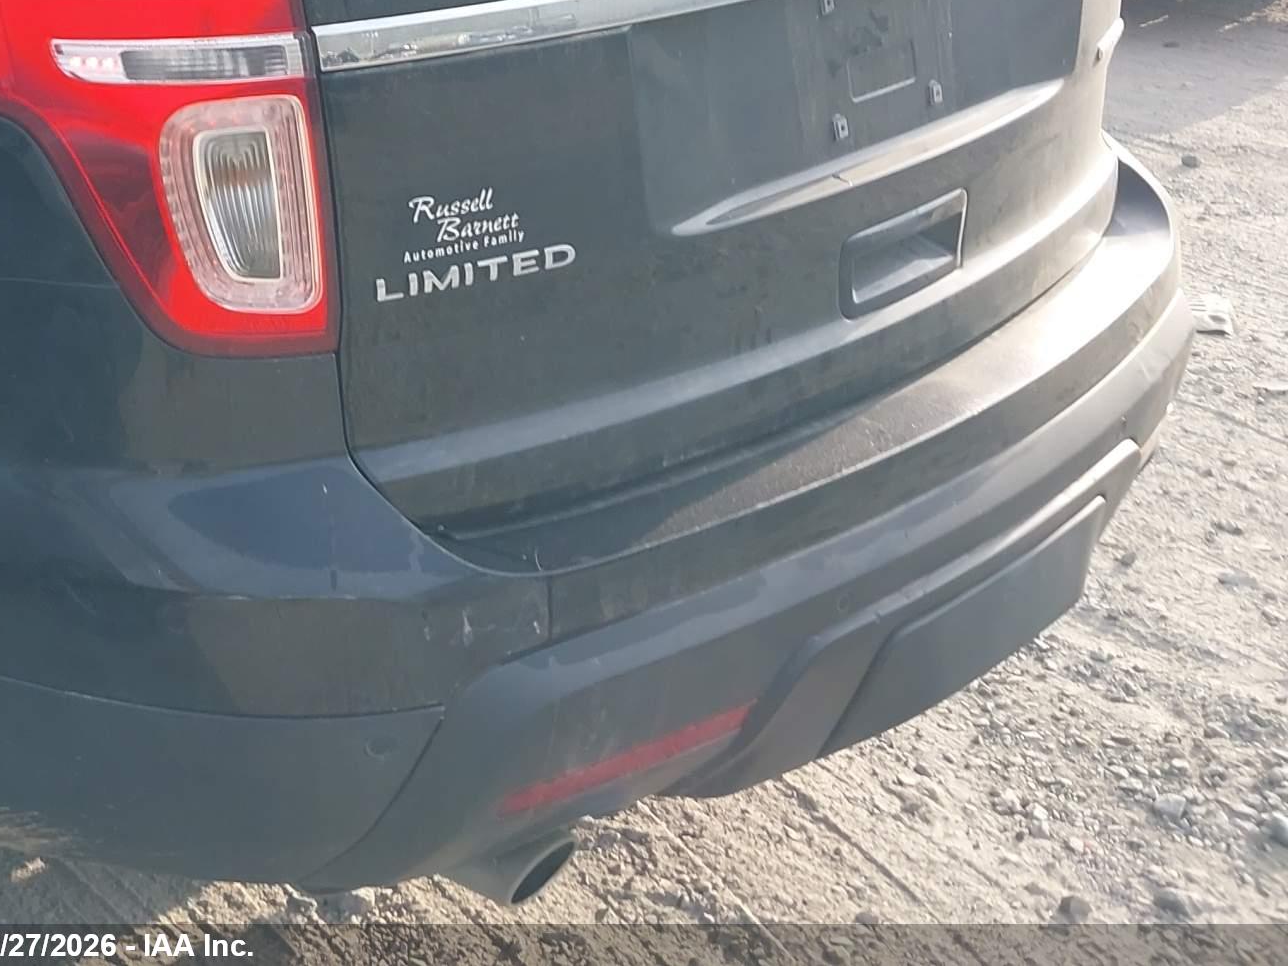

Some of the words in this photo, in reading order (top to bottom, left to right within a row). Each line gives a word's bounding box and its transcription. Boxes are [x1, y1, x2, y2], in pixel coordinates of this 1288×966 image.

[408, 187, 494, 223] Russell
[436, 212, 520, 242] Barnett
[403, 238, 479, 264] Automotive
[484, 230, 525, 248] Family
[376, 244, 576, 302] LIMITED
